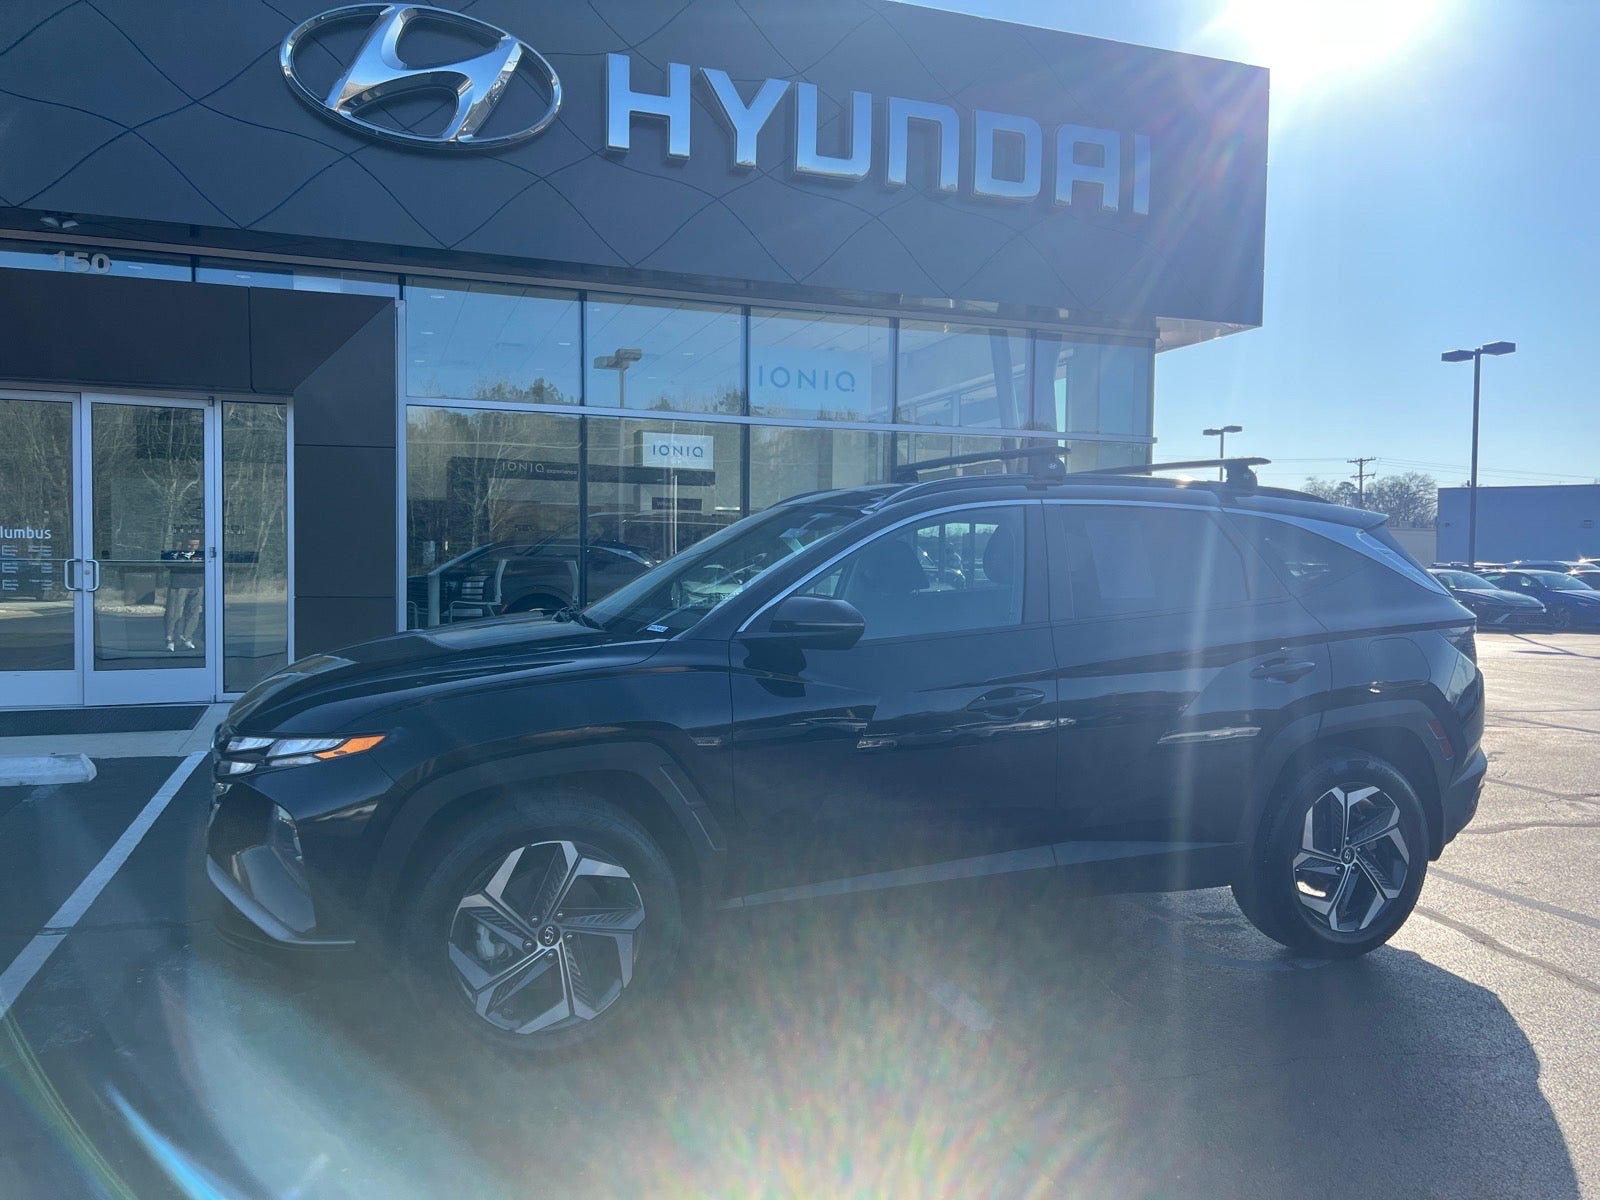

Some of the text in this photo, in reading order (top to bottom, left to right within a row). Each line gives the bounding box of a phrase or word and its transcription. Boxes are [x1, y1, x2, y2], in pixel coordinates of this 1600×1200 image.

[606, 53, 1151, 215] HYUNDAI
[53, 250, 111, 274] 150
[758, 365, 856, 393] IONIQ
[652, 444, 704, 458] IONIQ
[502, 461, 545, 473] IONIQ
